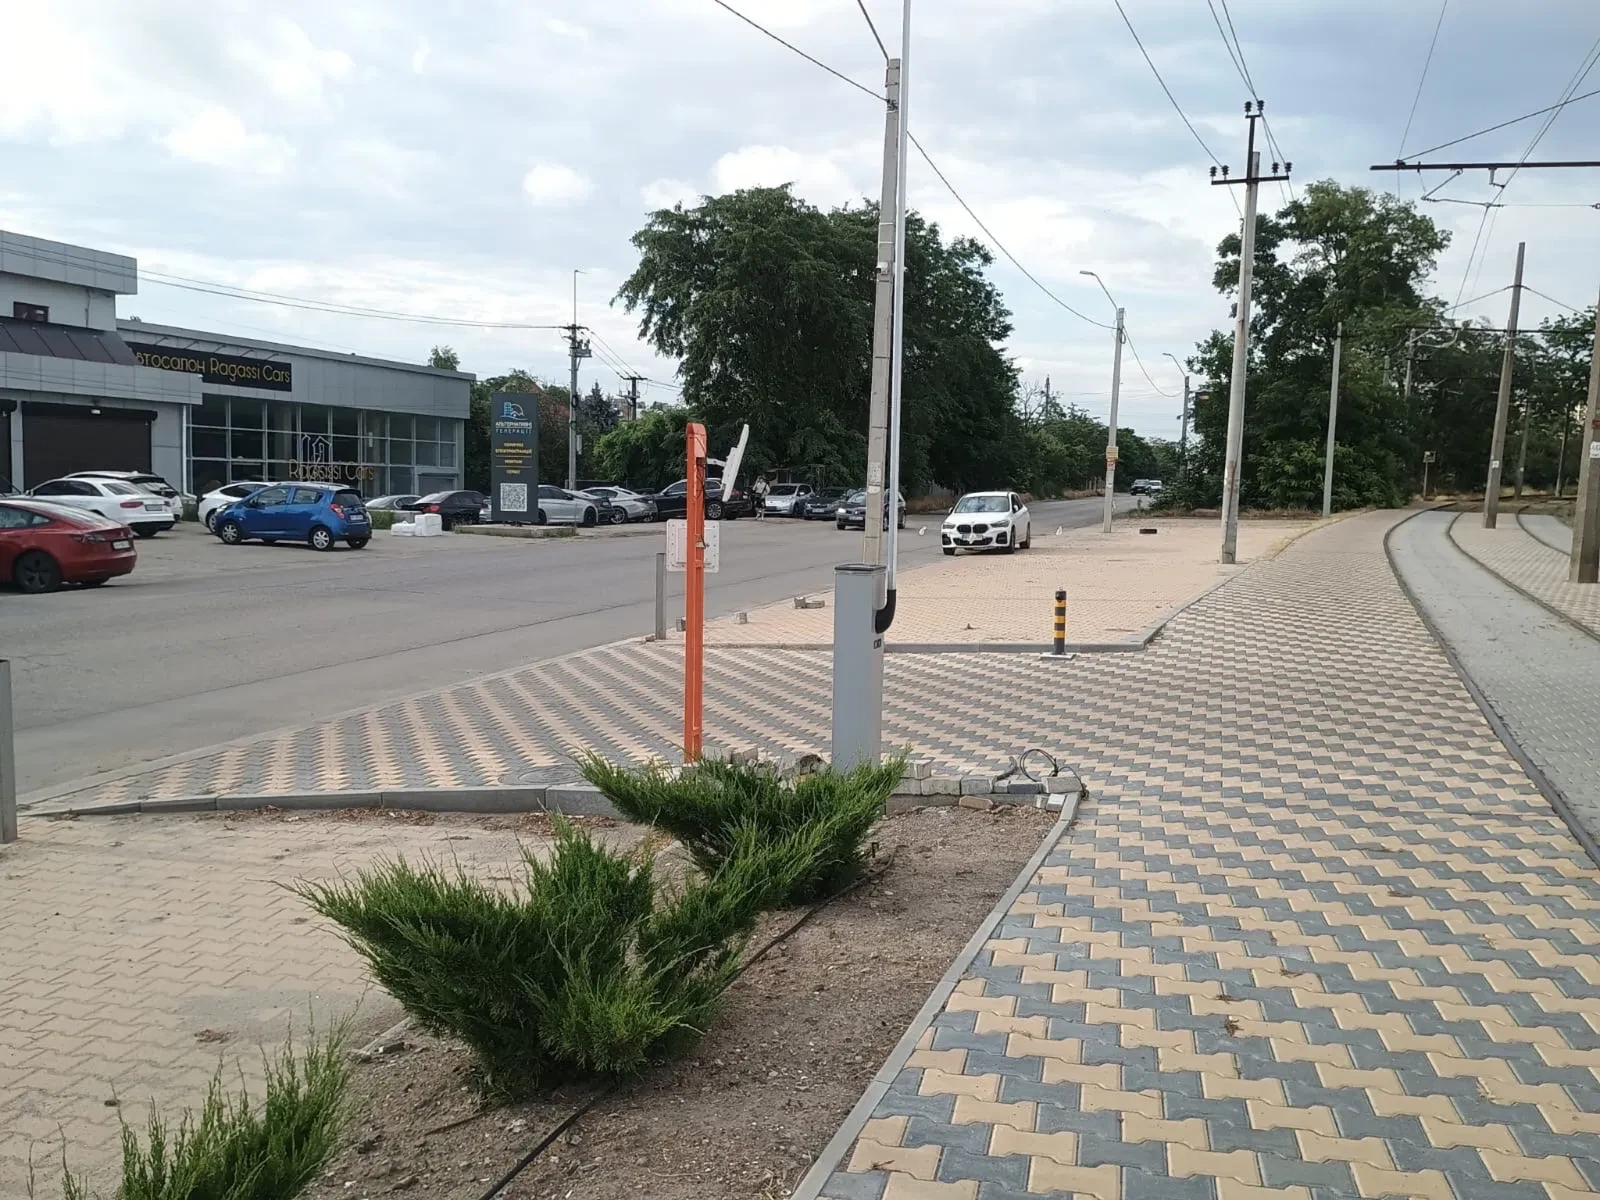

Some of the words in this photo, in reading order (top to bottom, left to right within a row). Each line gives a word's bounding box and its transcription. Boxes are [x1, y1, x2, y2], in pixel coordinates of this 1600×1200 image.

[136, 352, 206, 373] втосалон
[210, 358, 261, 382] Ragassi
[262, 365, 290, 383] Cars
[345, 461, 375, 481] Cars
